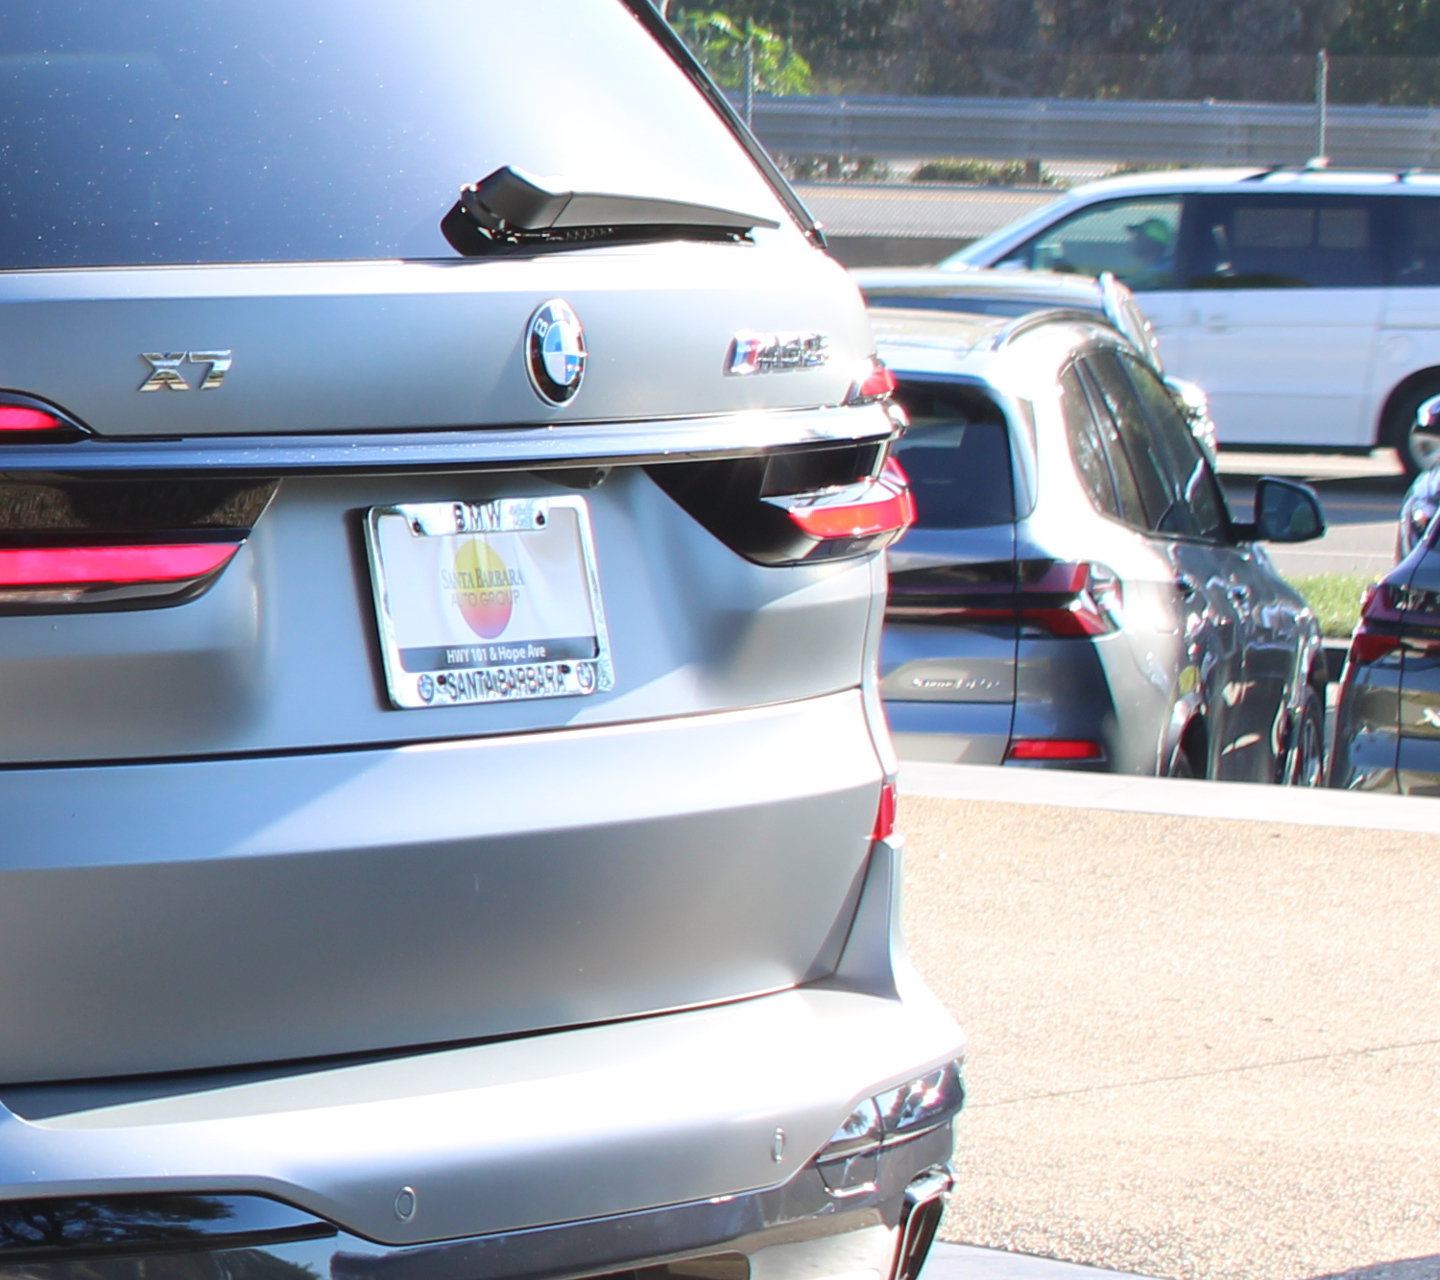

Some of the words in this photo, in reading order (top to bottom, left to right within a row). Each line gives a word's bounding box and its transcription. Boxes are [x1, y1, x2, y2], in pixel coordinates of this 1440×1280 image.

[138, 349, 233, 391] X7
[453, 500, 501, 531] BMW
[441, 568, 475, 590] SANTA
[475, 567, 525, 589] BARBARA
[451, 591, 478, 607] AUTO
[479, 590, 520, 606] GROUP
[446, 649, 470, 664] HWY
[471, 647, 487, 662] 101
[489, 646, 497, 660] &
[497, 645, 526, 663] Hope
[527, 644, 546, 658] Ave
[447, 670, 492, 701] SANTA
[496, 664, 565, 697] BARBARA
